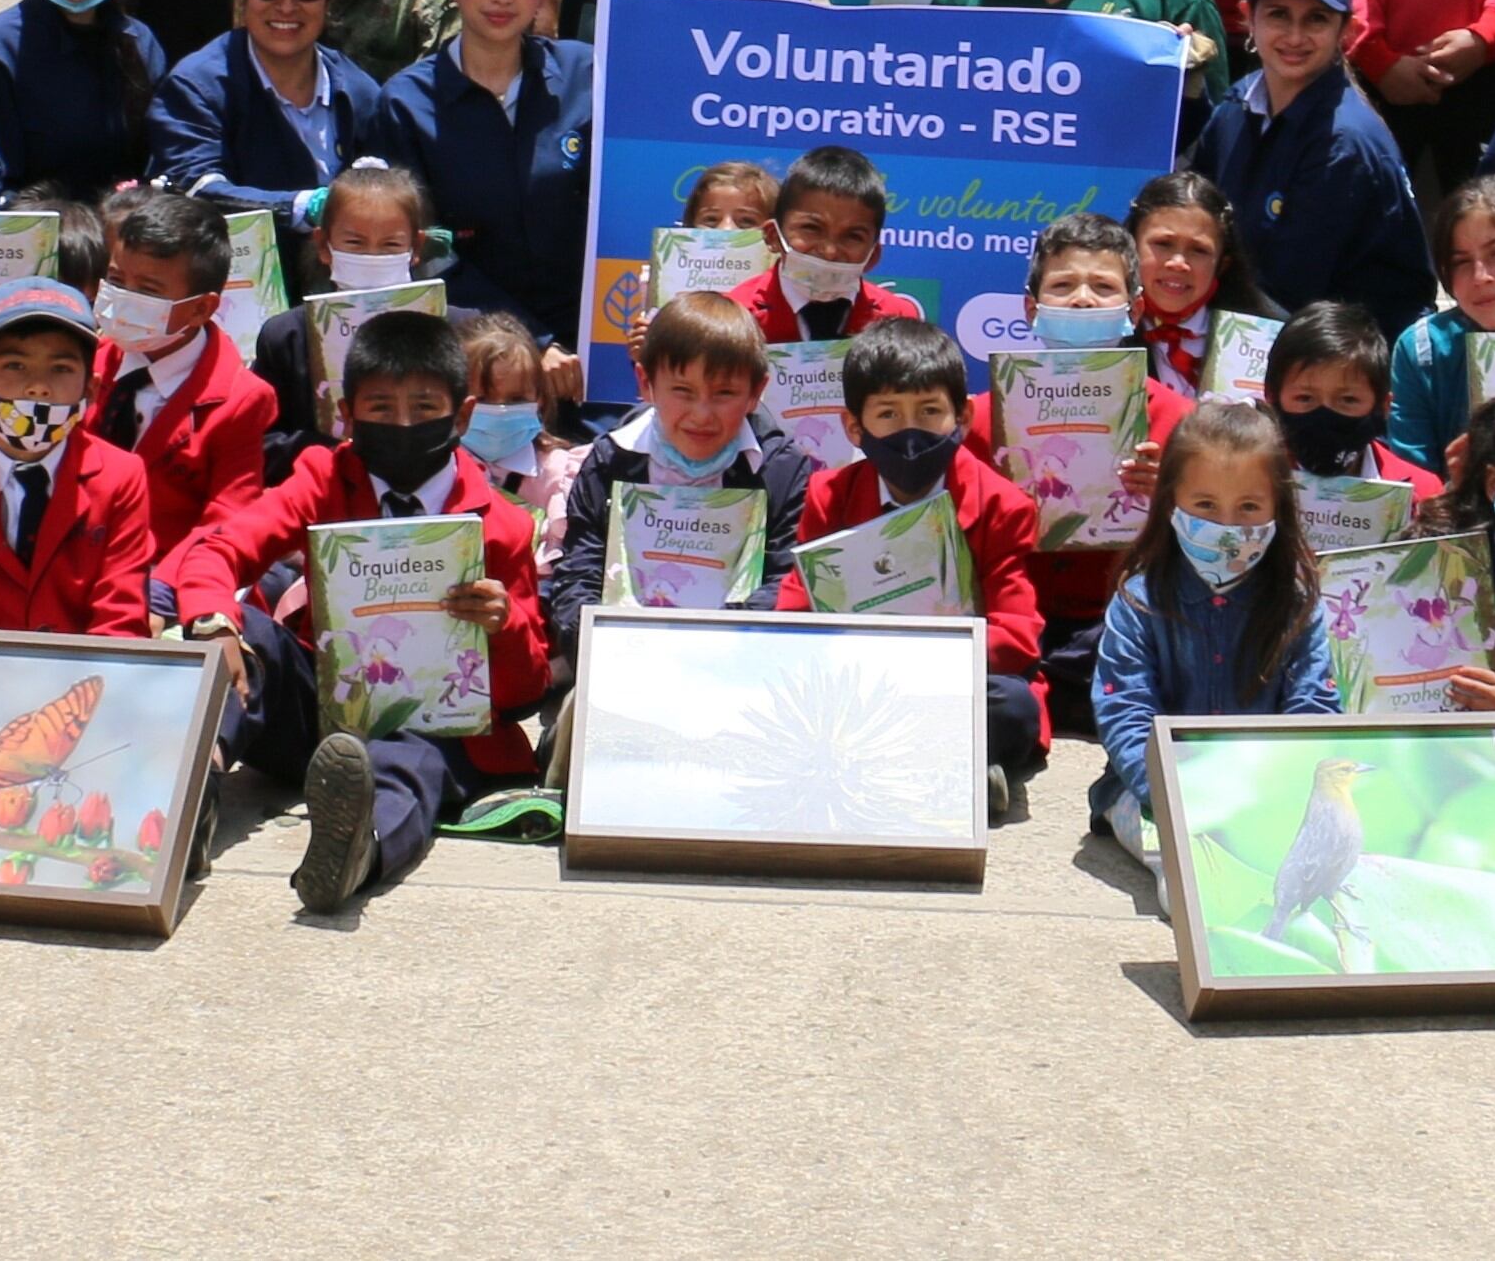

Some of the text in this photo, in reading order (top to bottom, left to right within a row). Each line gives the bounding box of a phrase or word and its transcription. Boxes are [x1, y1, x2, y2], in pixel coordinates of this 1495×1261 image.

[691, 28, 1082, 96] Voluntariado
[691, 92, 1078, 148] Corporativo - RSE
[919, 178, 1099, 223] voluntad
[984, 231, 1038, 260] mej
